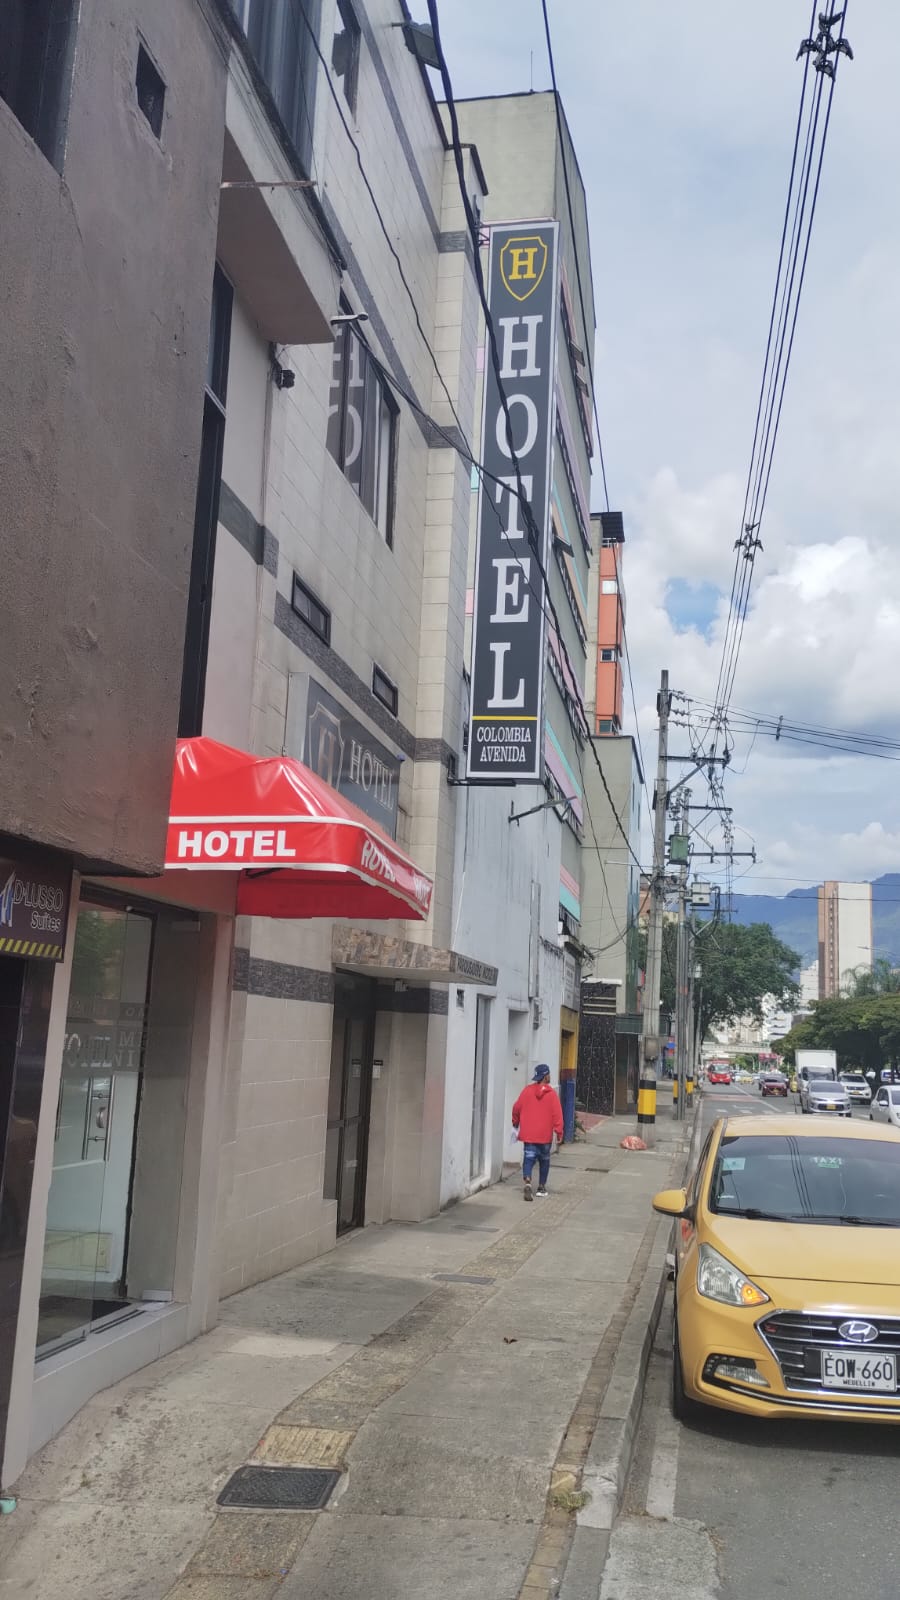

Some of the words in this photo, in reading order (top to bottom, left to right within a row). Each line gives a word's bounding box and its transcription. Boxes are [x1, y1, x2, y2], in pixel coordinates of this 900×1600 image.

[508, 247, 538, 282] H
[487, 314, 543, 710] HOTEL
[476, 726, 532, 742] COLOMBIA
[479, 745, 526, 762] AVENIDA
[349, 739, 395, 811] HOTEL
[177, 830, 296, 858] HOTEL
[31, 910, 62, 933] Suites
[811, 1156, 843, 1165] TAXI
